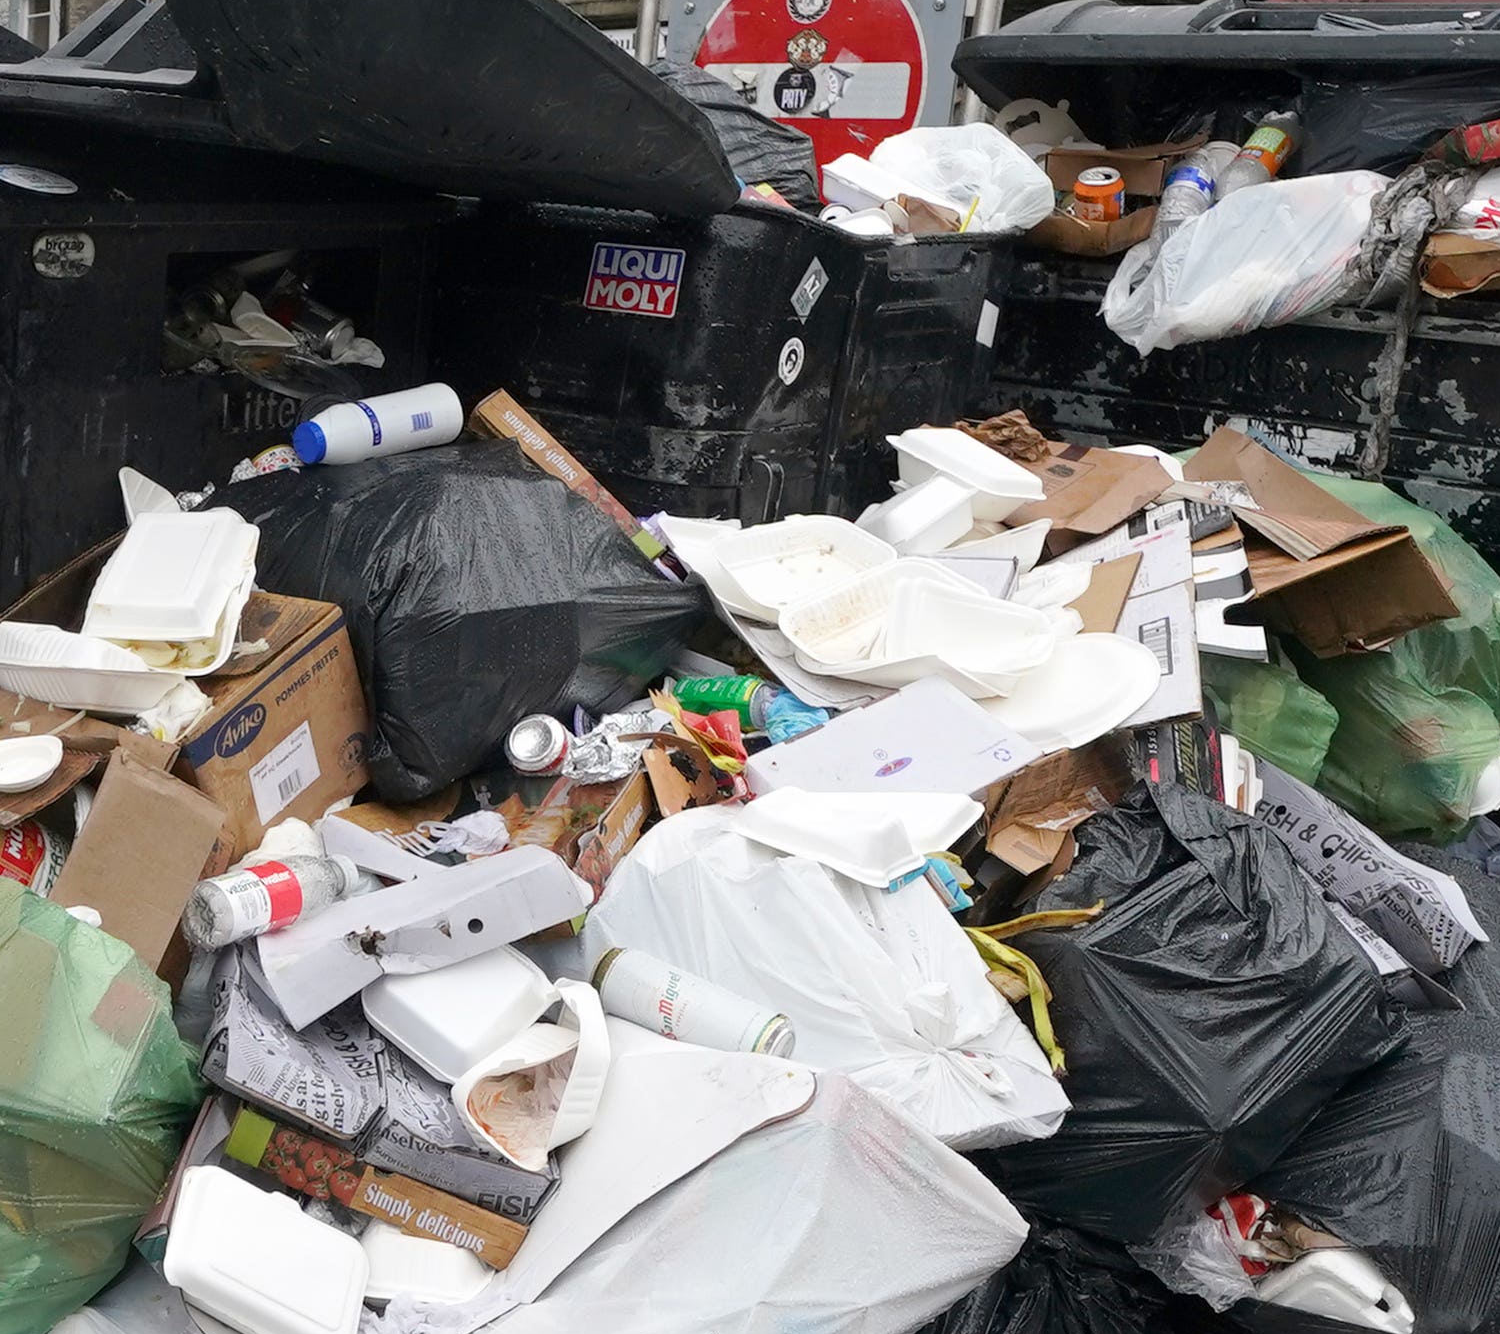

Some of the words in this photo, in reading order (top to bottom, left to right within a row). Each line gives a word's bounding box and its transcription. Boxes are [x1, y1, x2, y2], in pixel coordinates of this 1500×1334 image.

[597, 248, 678, 281] LIQUI
[590, 279, 675, 312] MOLY
[223, 392, 297, 433] Litte
[502, 410, 548, 450] delicious
[545, 448, 578, 482] Simply
[275, 673, 311, 706] POMMES
[311, 646, 340, 675] FRITES
[1298, 824, 1317, 843] &
[659, 970, 681, 1016] Miguel
[364, 1183, 417, 1222] Simply
[416, 1208, 487, 1253] delicious
